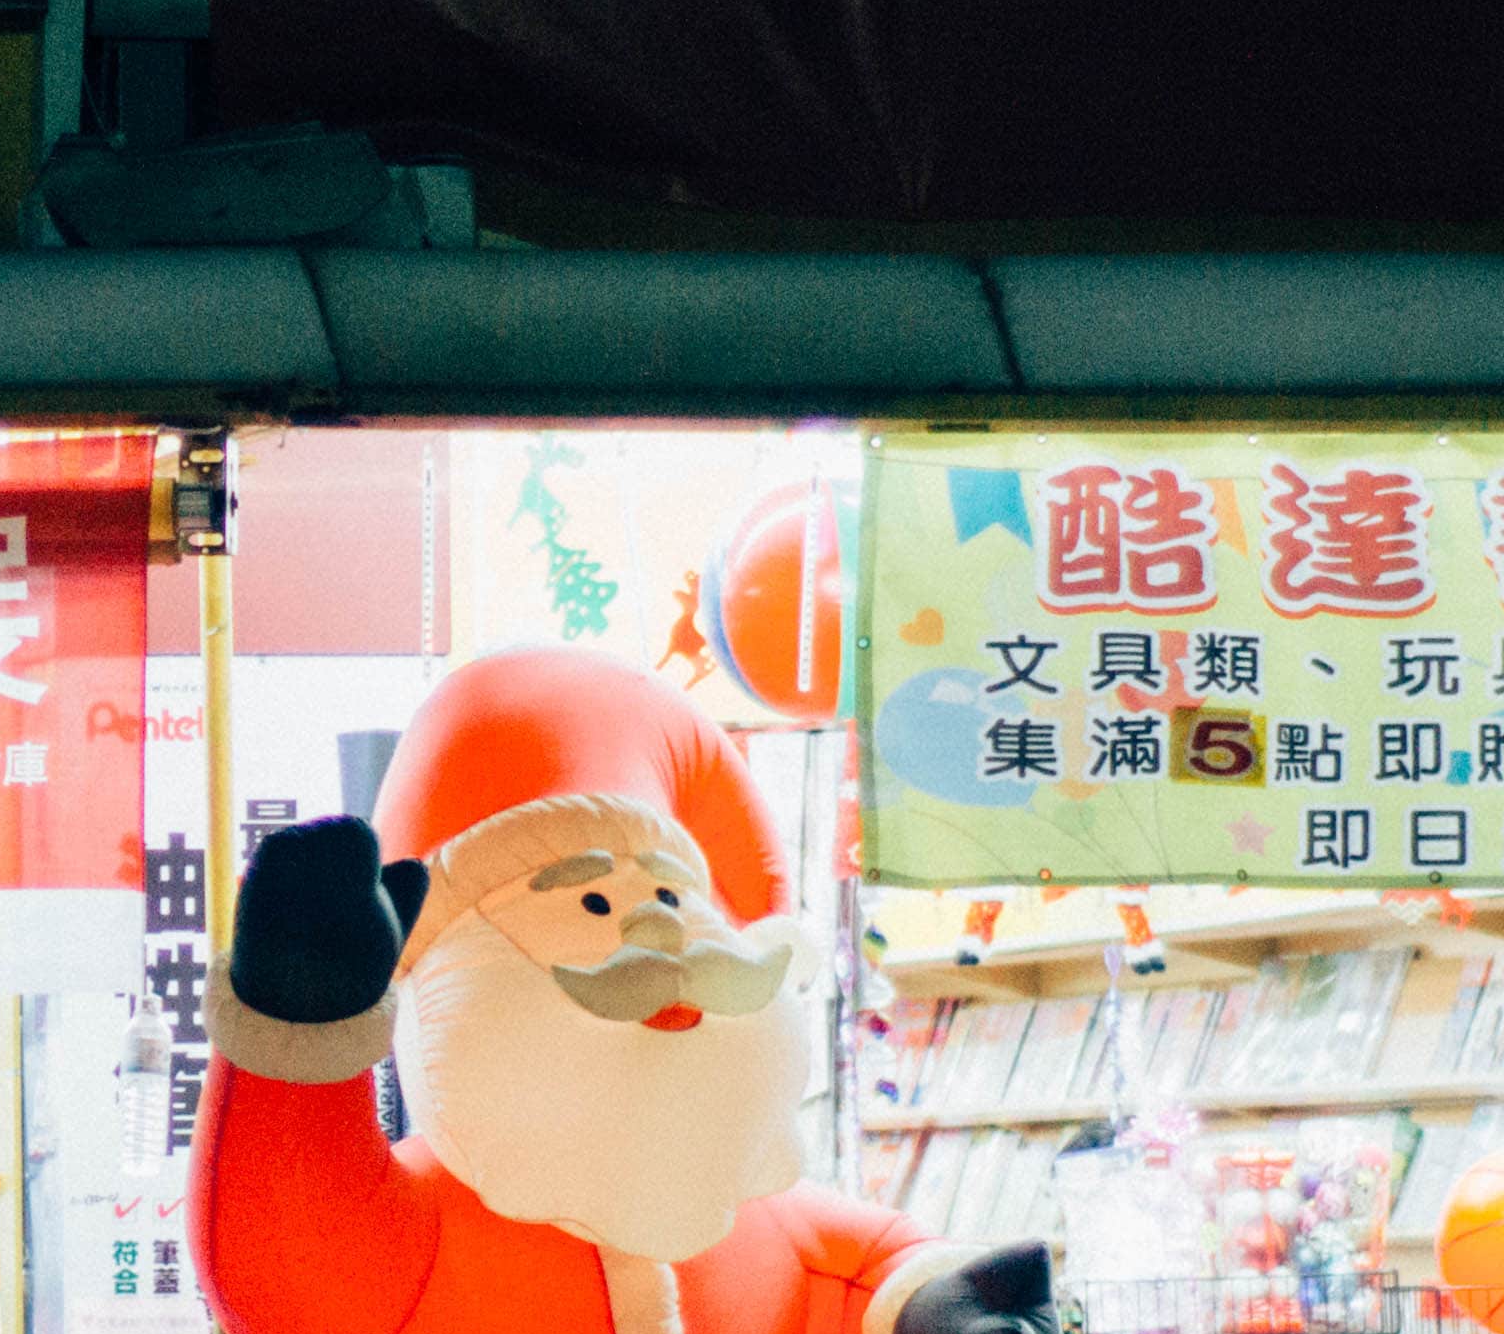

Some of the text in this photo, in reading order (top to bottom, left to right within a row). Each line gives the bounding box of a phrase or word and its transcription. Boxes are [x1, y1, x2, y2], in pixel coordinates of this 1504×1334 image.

[86, 701, 205, 743] Pentel
[113, 1240, 139, 1295] 符合
[153, 1240, 180, 1295] 筆蓋
